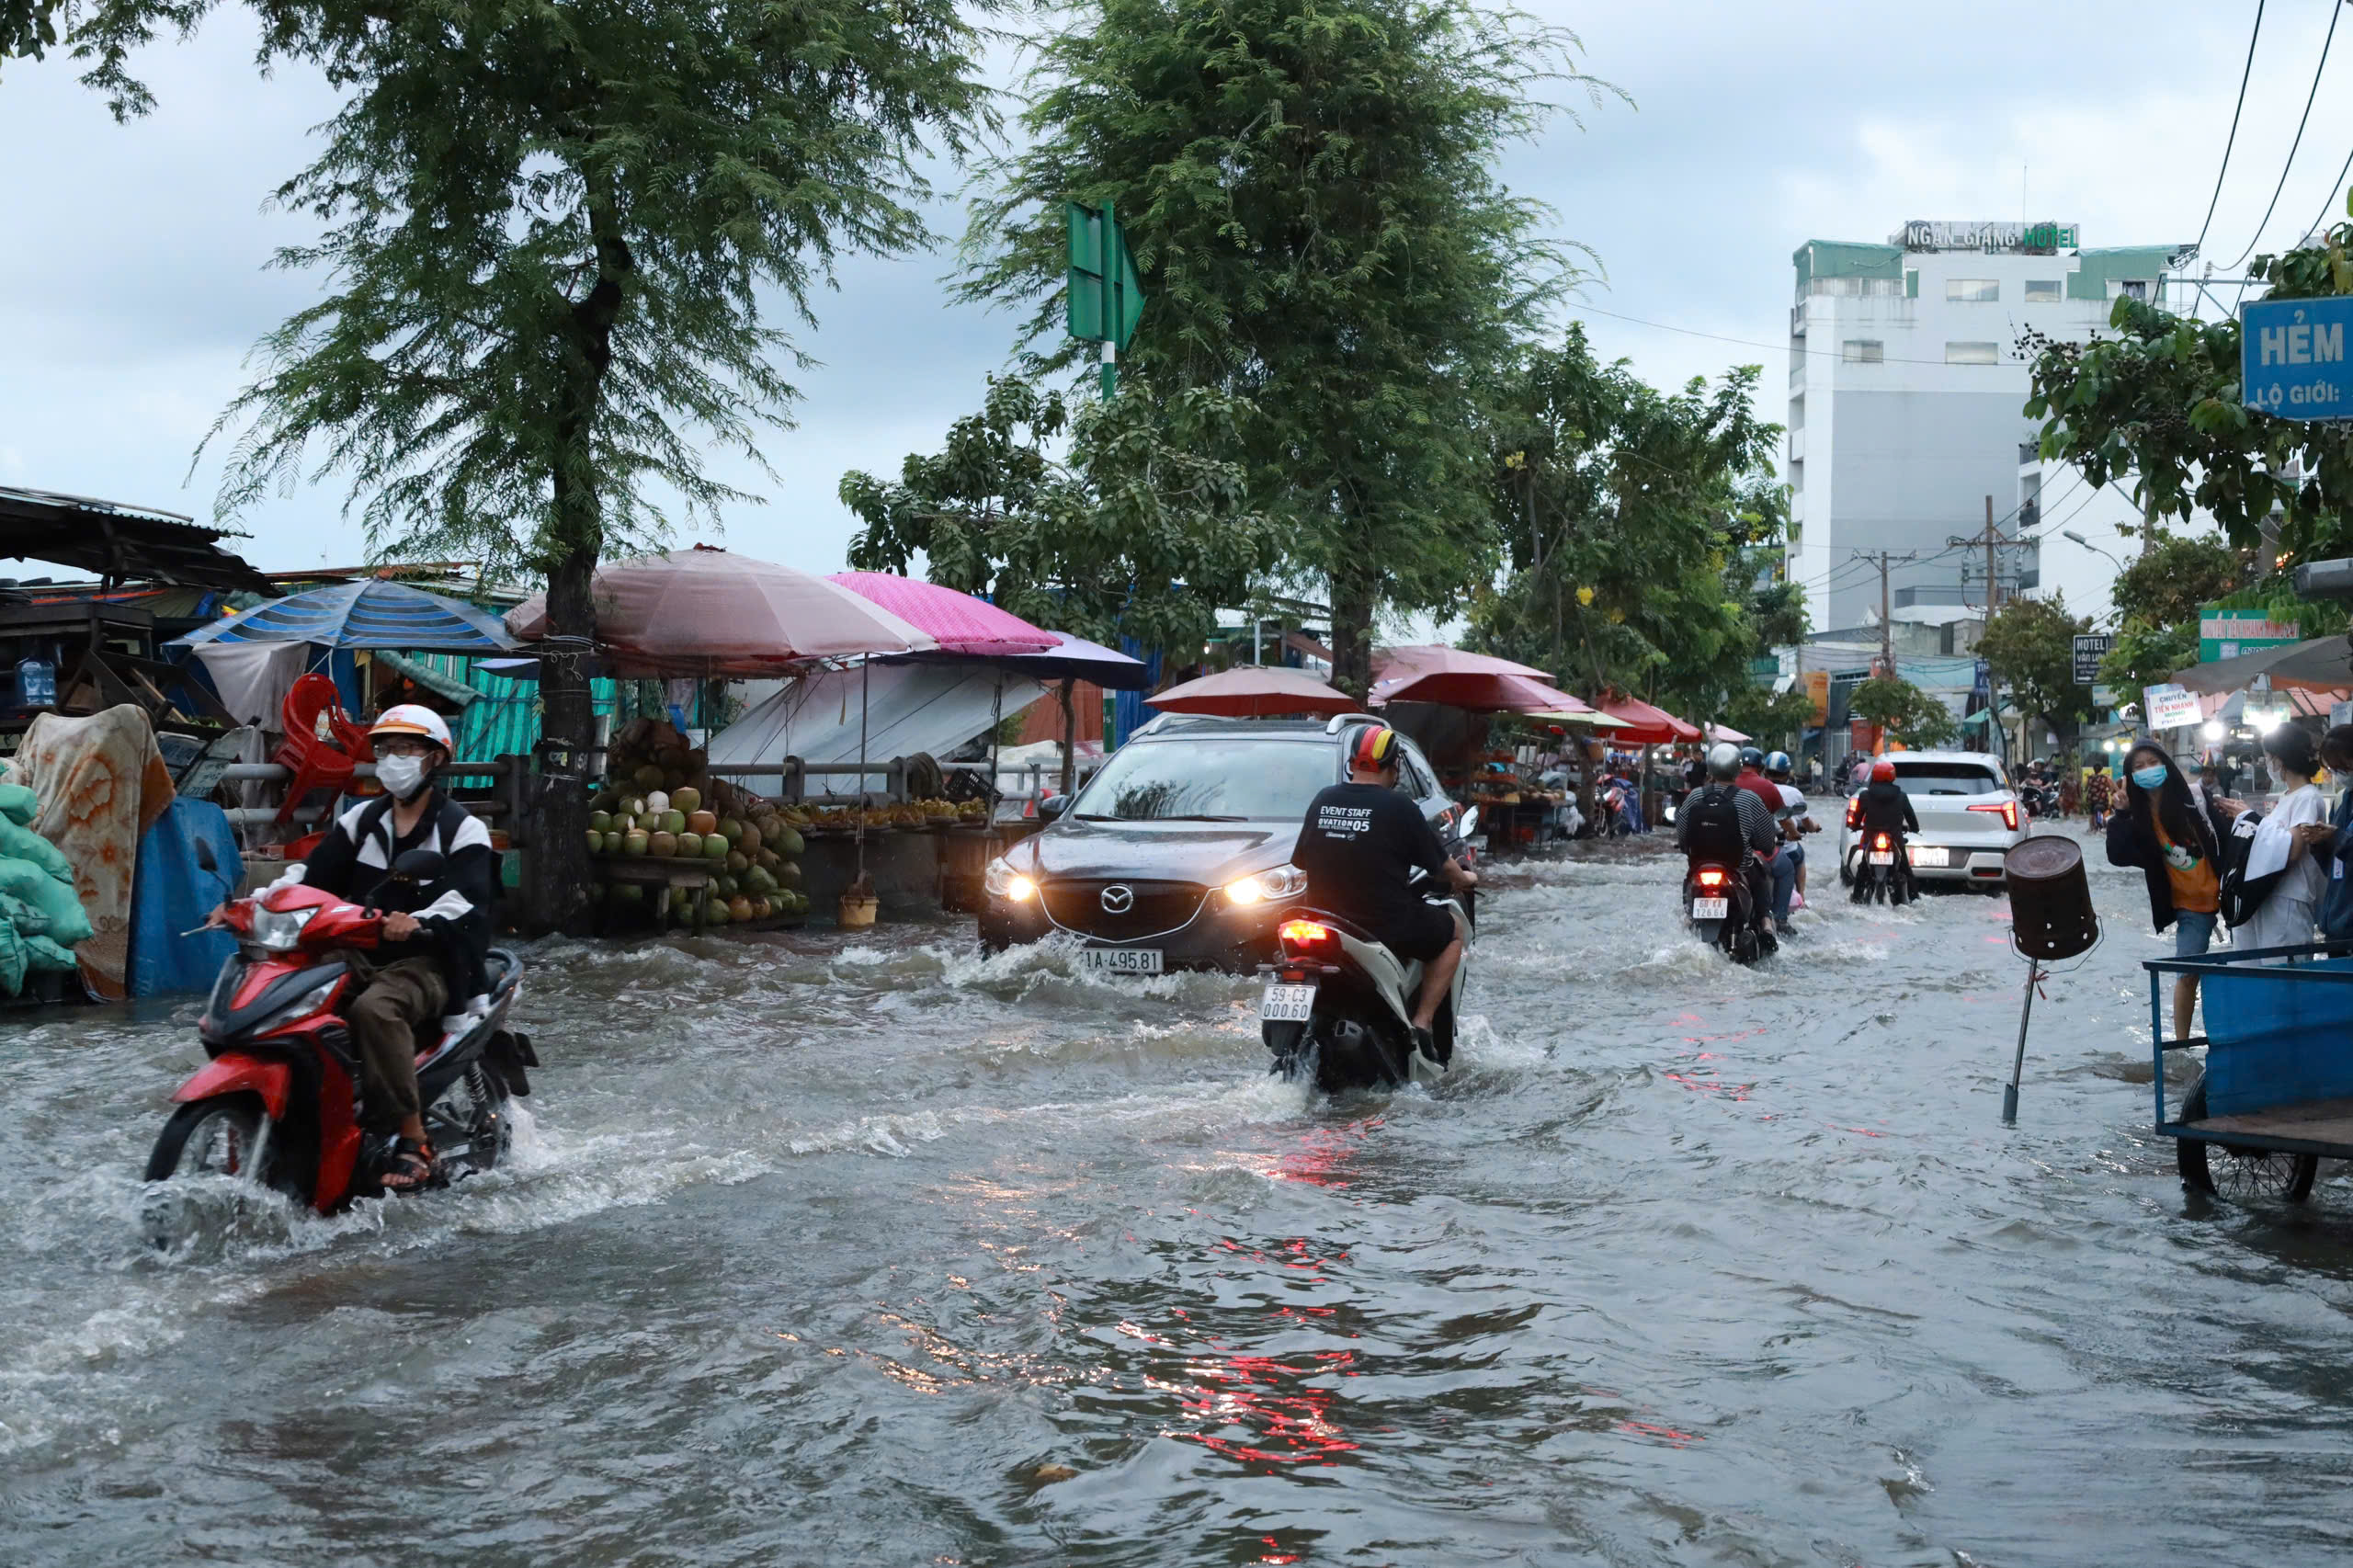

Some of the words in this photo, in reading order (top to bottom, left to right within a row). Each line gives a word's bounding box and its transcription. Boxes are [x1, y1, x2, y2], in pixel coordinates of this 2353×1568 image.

[1964, 228, 2016, 246] GIANG
[2024, 228, 2079, 248] HOTEL
[2261, 310, 2343, 366] HẺM
[2256, 382, 2283, 411] LỘ
[2290, 379, 2339, 404] GIỚI:
[2076, 638, 2105, 651] HOTEL
[1320, 806, 1347, 816] EVENT
[1347, 808, 1372, 817] STAFF
[1318, 818, 1352, 826] OVATION
[1352, 820, 1370, 832] 05
[1264, 1003, 1308, 1018] 000.60
